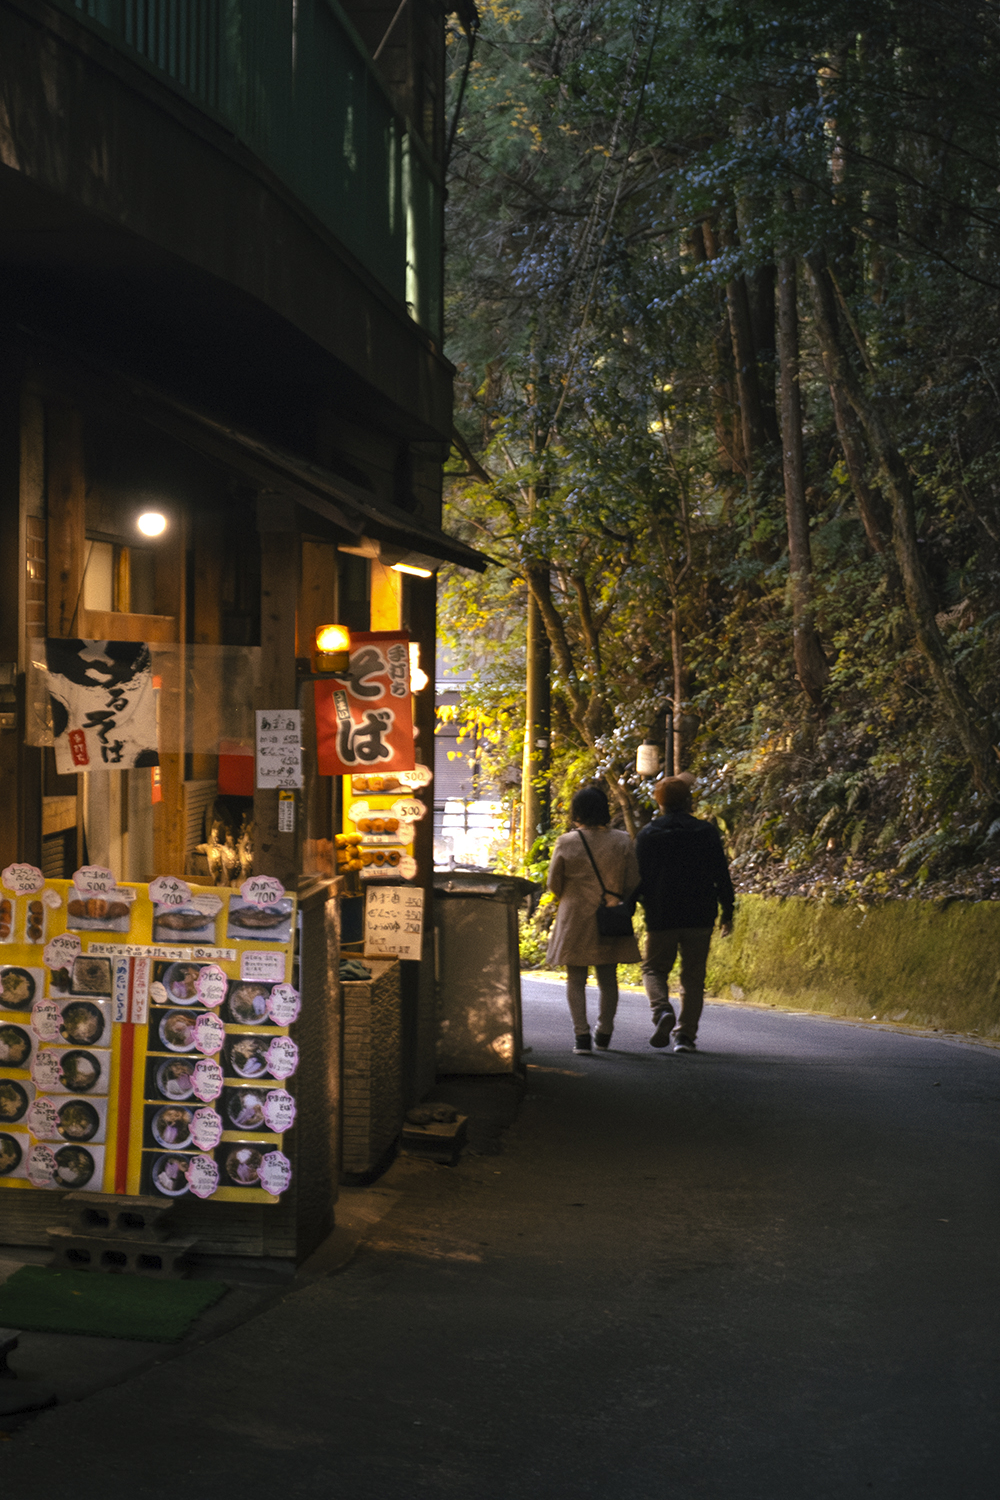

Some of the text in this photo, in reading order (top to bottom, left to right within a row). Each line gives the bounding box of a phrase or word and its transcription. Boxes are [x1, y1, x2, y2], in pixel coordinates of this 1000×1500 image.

[335, 645, 395, 766] そば
[401, 806, 420, 816] 500
[255, 892, 276, 904] 700
